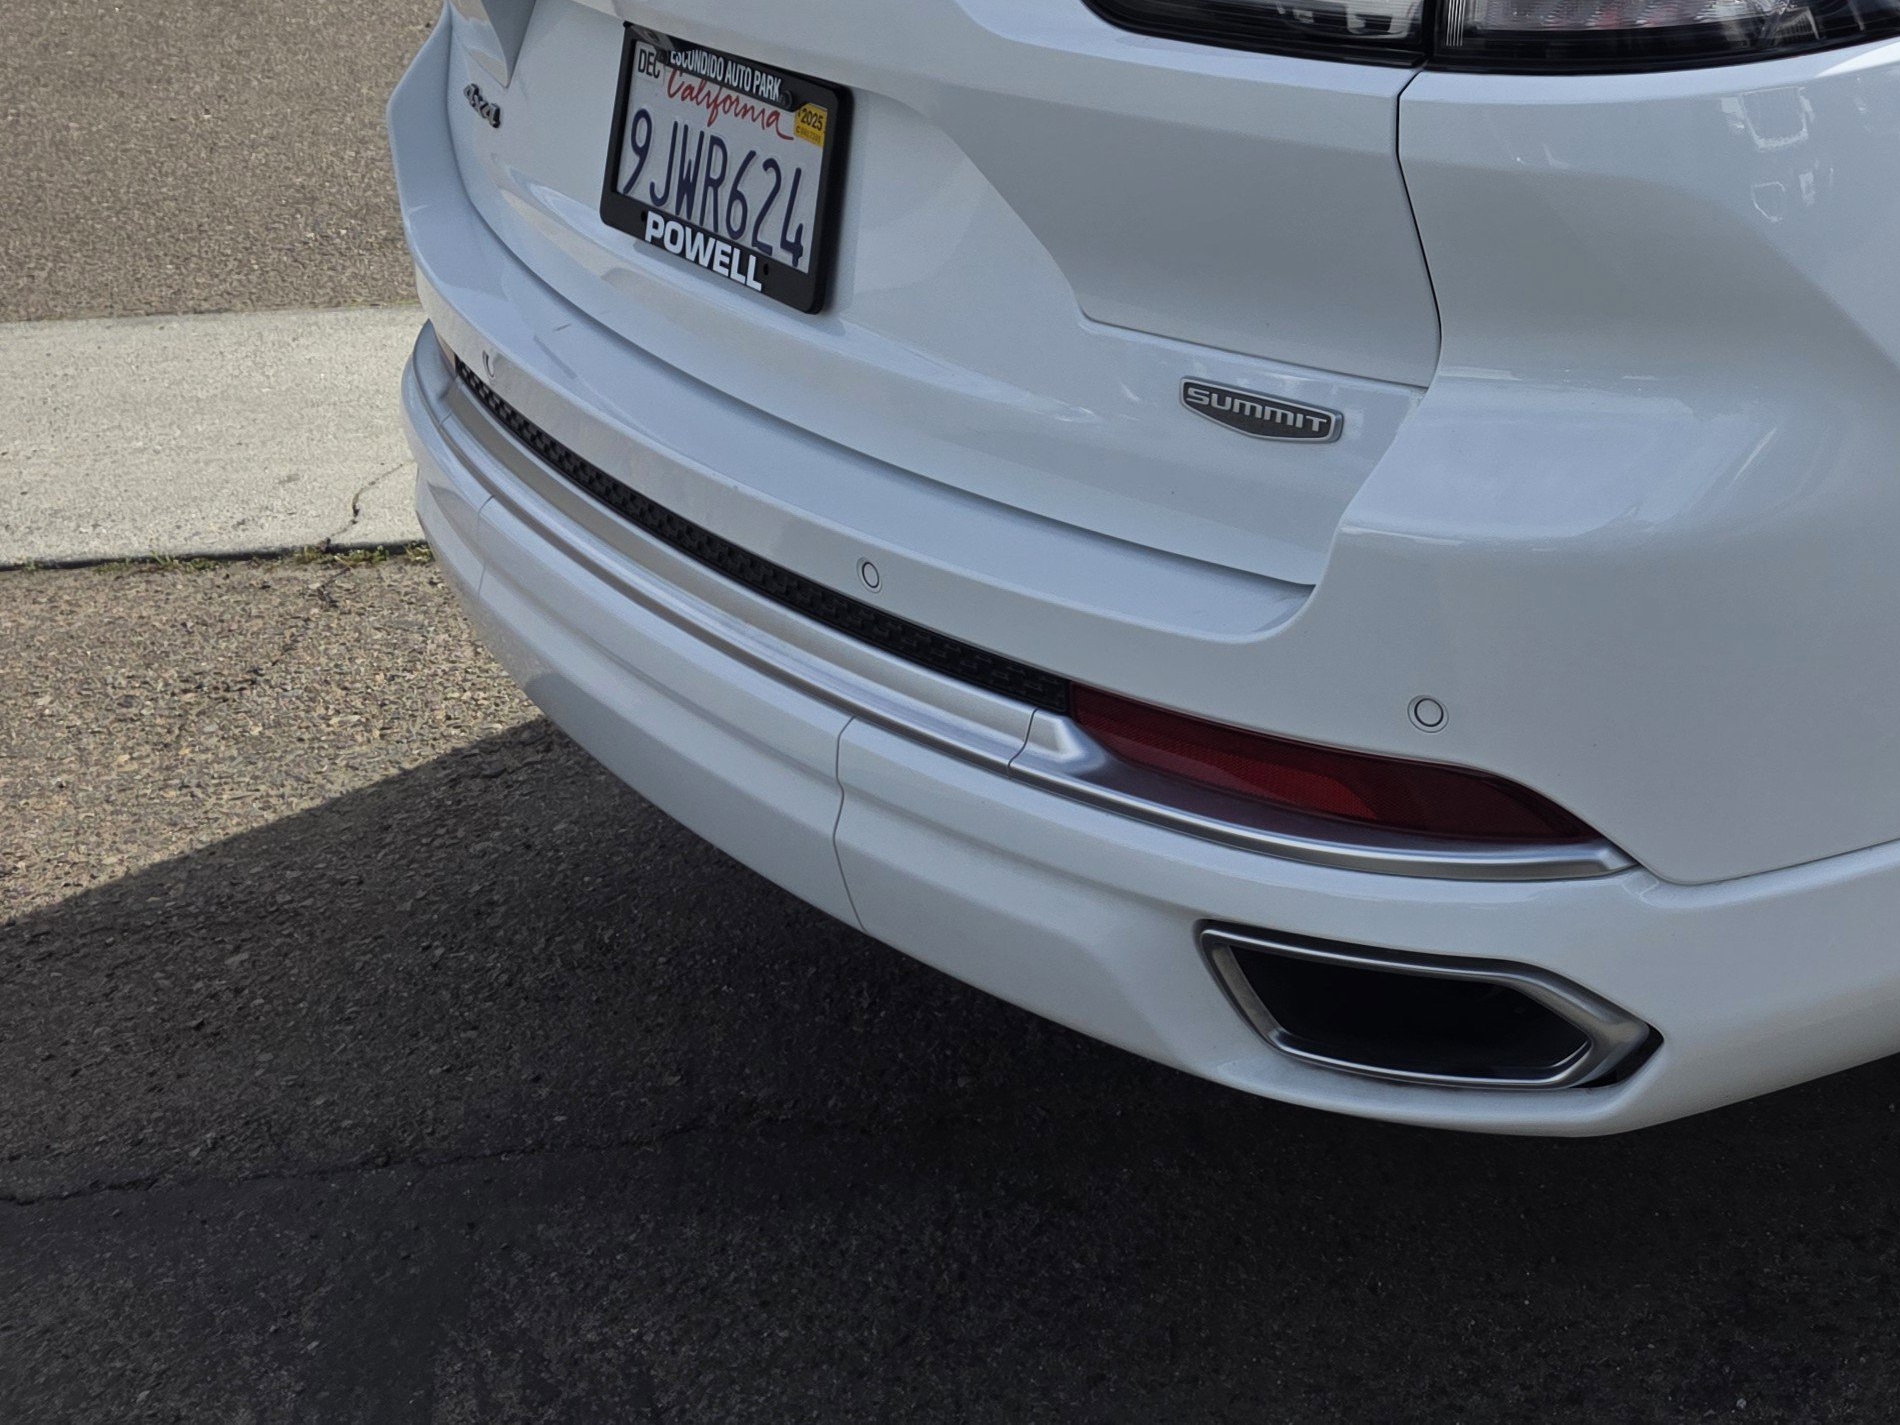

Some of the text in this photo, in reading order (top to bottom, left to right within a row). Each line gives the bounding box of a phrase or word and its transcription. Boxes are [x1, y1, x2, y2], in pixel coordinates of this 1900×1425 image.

[637, 49, 660, 79] DEC
[725, 60, 752, 92] AUTO
[752, 71, 781, 103] PARK
[667, 69, 794, 141] California
[800, 108, 824, 132] 2025
[622, 107, 804, 268] 9JWR624
[644, 210, 762, 293] POWELL
[1186, 386, 1328, 432] SUMMIT
